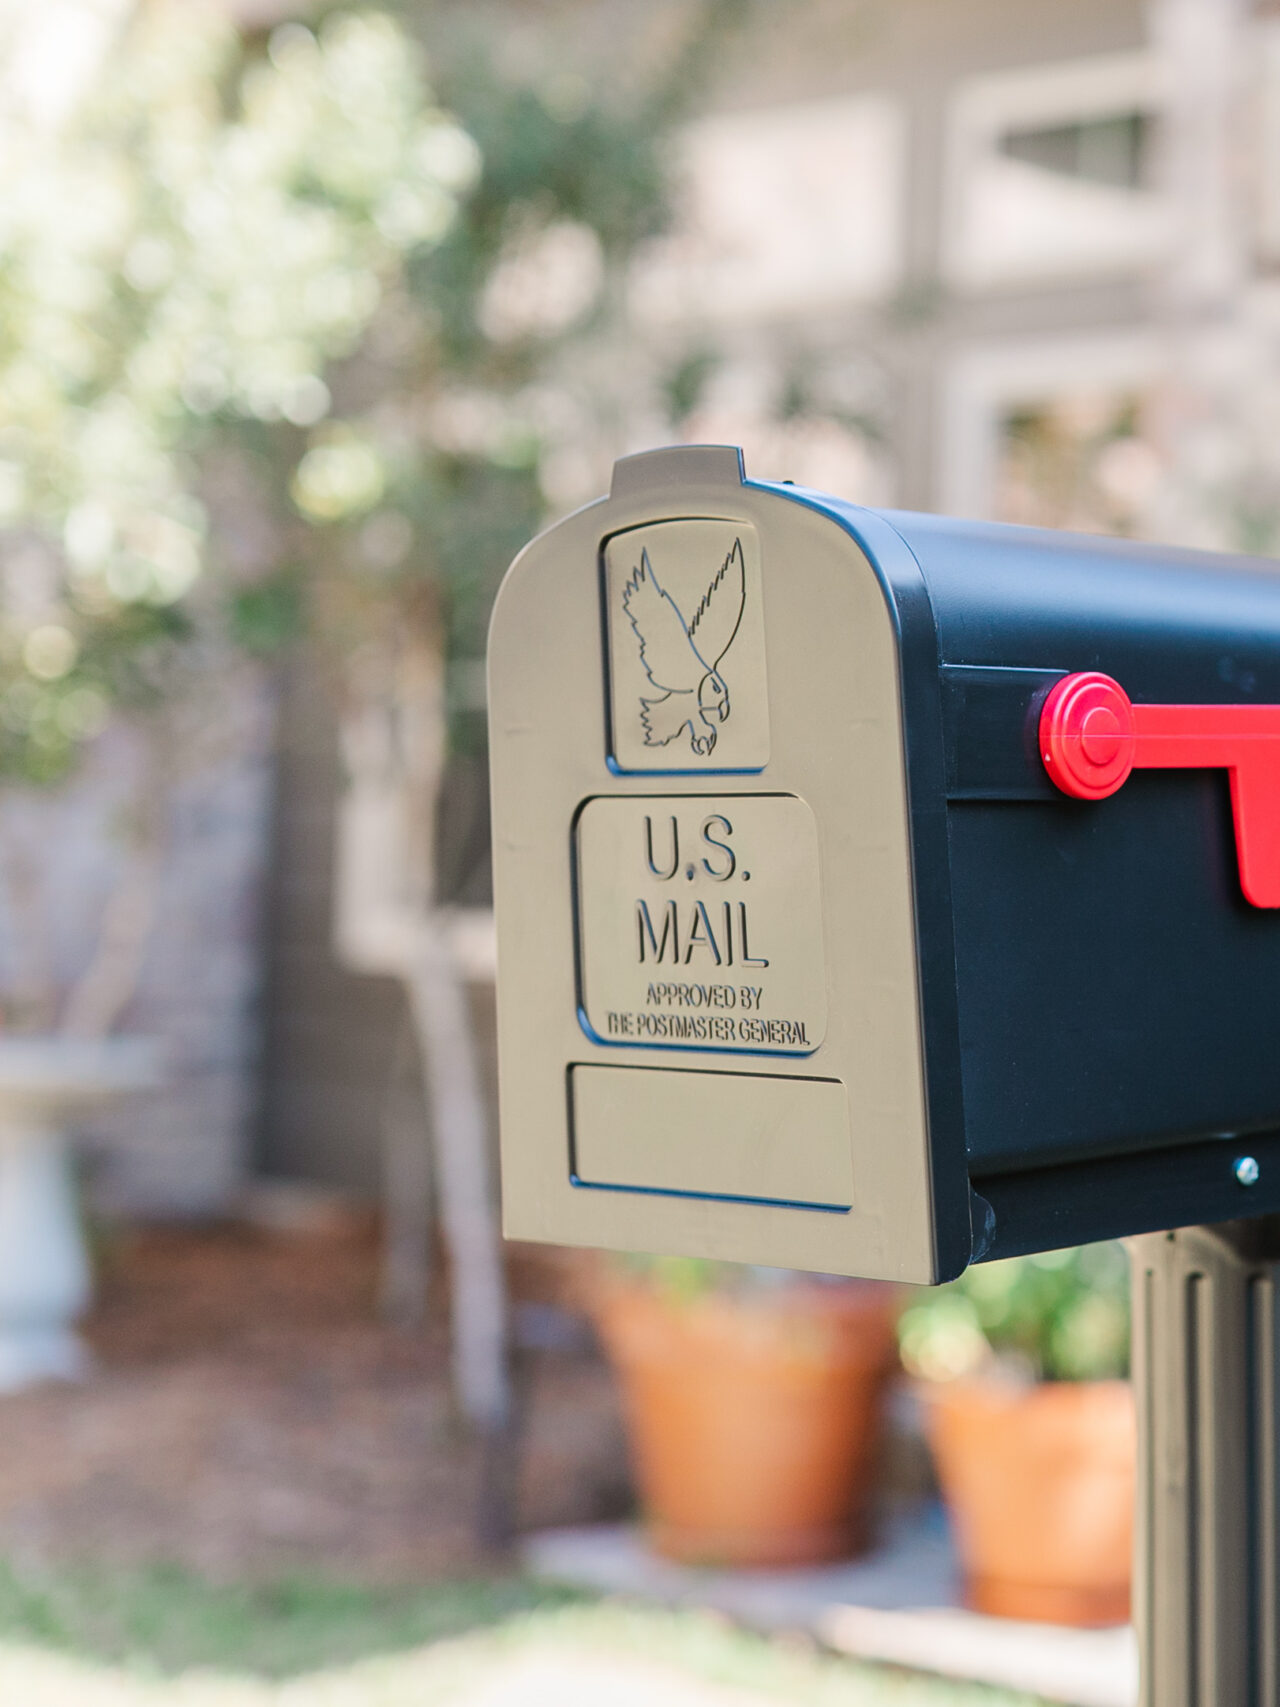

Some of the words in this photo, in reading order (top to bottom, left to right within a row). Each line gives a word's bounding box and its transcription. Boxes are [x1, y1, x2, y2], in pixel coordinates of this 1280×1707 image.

[644, 814, 751, 881] U.S.
[636, 899, 769, 968] MAIL
[646, 982, 736, 1009] APPROVED
[740, 986, 763, 1011] BY
[607, 1011, 634, 1036] THE
[637, 1012, 736, 1041] POSTMASTER
[739, 1018, 811, 1046] GENERAL
